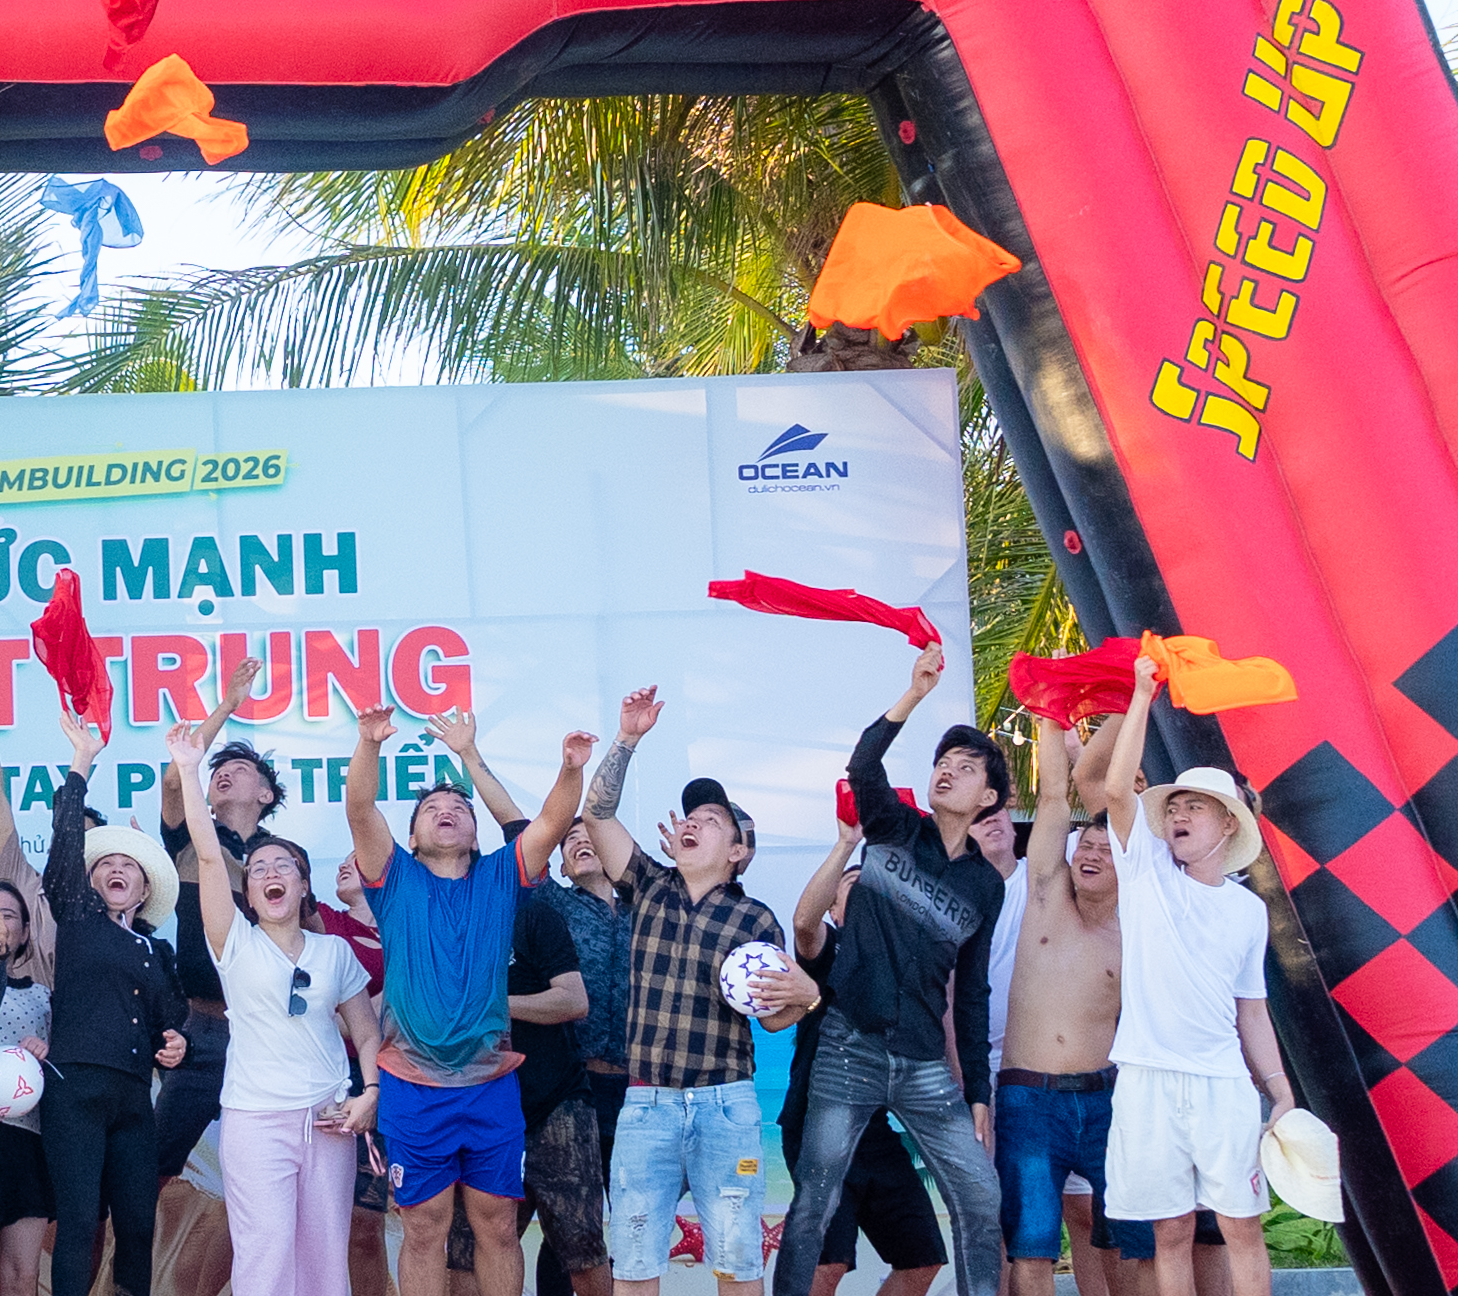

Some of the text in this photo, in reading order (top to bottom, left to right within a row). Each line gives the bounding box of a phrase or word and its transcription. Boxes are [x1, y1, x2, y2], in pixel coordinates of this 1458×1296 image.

[1149, 137, 1328, 462] SPEED
[201, 454, 281, 483] 2026
[738, 461, 848, 480] OCEAN
[748, 484, 840, 493] dulichocean.vn
[101, 532, 358, 615] MẠNH
[896, 890, 930, 915] LONDO
